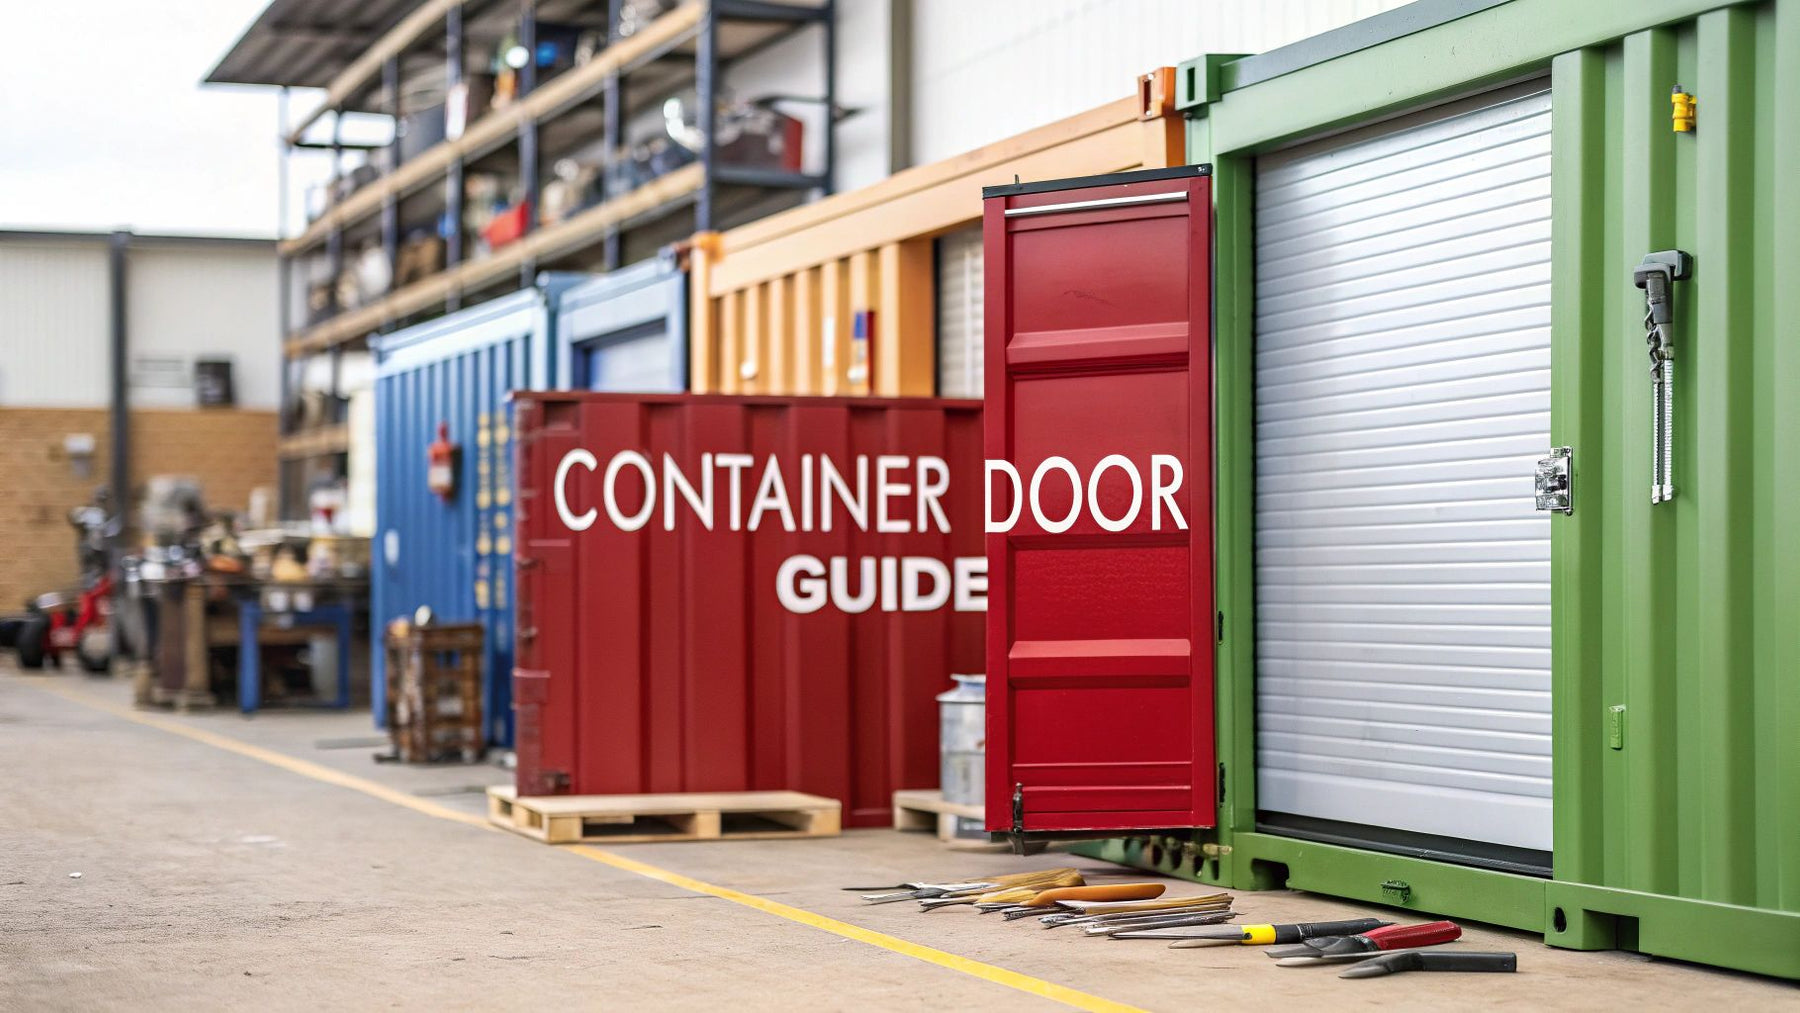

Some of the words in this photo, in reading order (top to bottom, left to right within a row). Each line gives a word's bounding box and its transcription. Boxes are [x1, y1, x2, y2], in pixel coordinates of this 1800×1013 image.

[554, 448, 952, 533] CONTAINER
[985, 453, 1189, 534] DOOR
[776, 556, 988, 613] GUIDE
